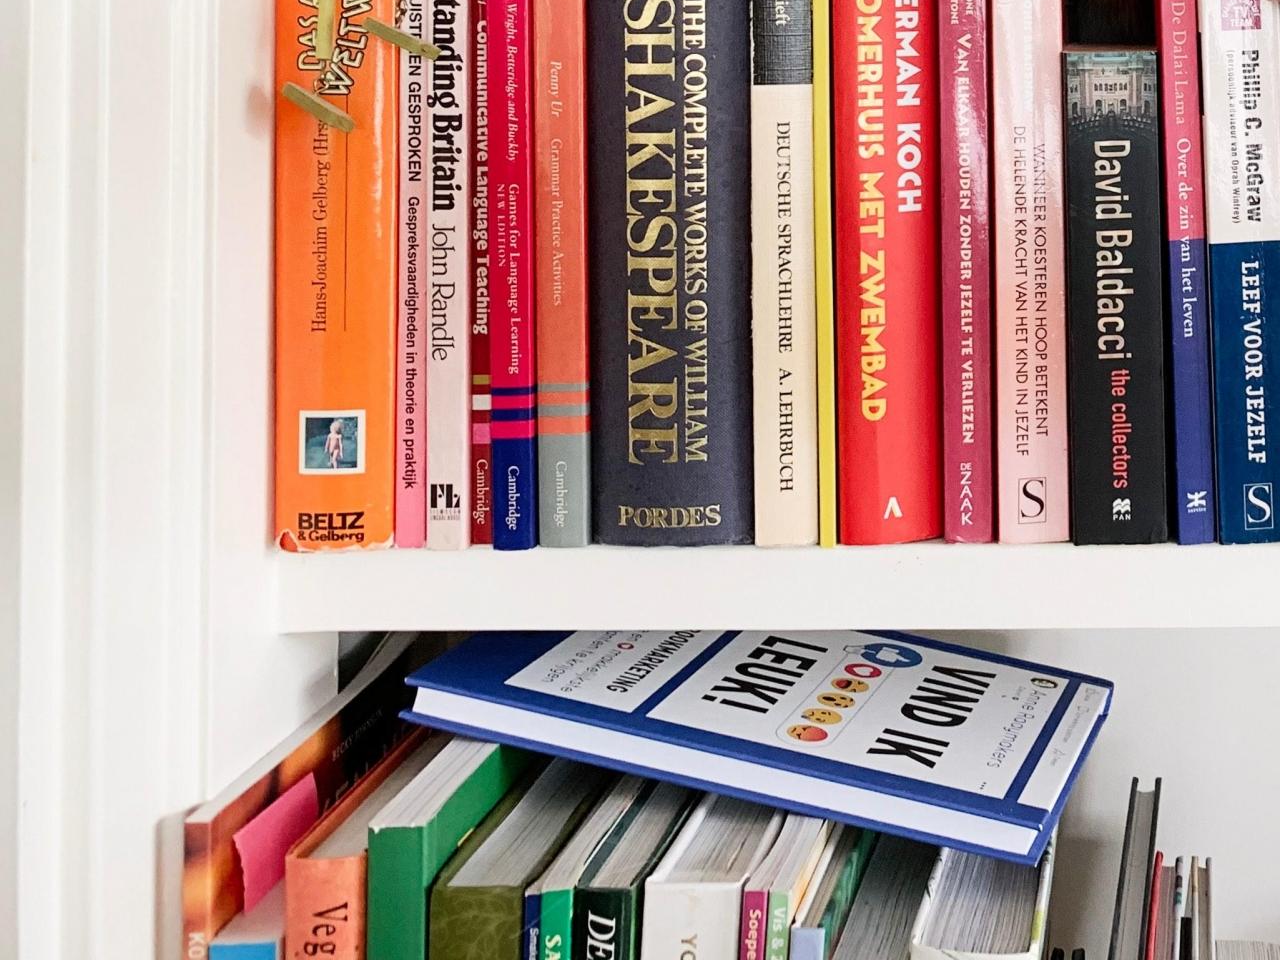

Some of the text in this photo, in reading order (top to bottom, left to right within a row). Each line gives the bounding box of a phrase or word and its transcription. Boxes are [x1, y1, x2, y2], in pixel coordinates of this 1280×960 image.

[432, 113, 463, 211] Britain
[683, 53, 708, 197] COMPLETE
[897, 123, 923, 212] KOCH
[859, 172, 885, 241] MET
[1245, 142, 1265, 222] McGraw
[402, 82, 423, 489] GESPROKEN Gespreksvaardigheden in theorie en praktijk
[432, 224, 456, 276] John
[684, 200, 709, 294] WORKS
[1177, 137, 1198, 338] Over leven
[431, 282, 456, 361] Randle
[684, 299, 709, 332] OF
[776, 122, 794, 493] DEUTSCHE SPRACHLEHRE A. LEHRBUCH
[859, 250, 888, 422] ZWEMBAD
[1034, 225, 1049, 437] KOESTEREN HOOP BETEKENT
[1094, 139, 1134, 489] David Baldacci the collectors
[473, 255, 490, 525] Teaching Cambridge
[684, 344, 709, 464] WILLIAM
[960, 283, 974, 444] JEZELF TE VERLIEZEN
[1016, 348, 1029, 457] KIND IN JEZELF
[1241, 261, 1267, 464] LEEF VOOR JEZELF
[298, 512, 365, 530] BELTZ
[298, 530, 365, 544] & Gelberg
[506, 465, 520, 531] Cambridge
[618, 504, 722, 529] PORDES
[701, 634, 829, 716] LEUK!
[867, 664, 998, 769] VIND IK
